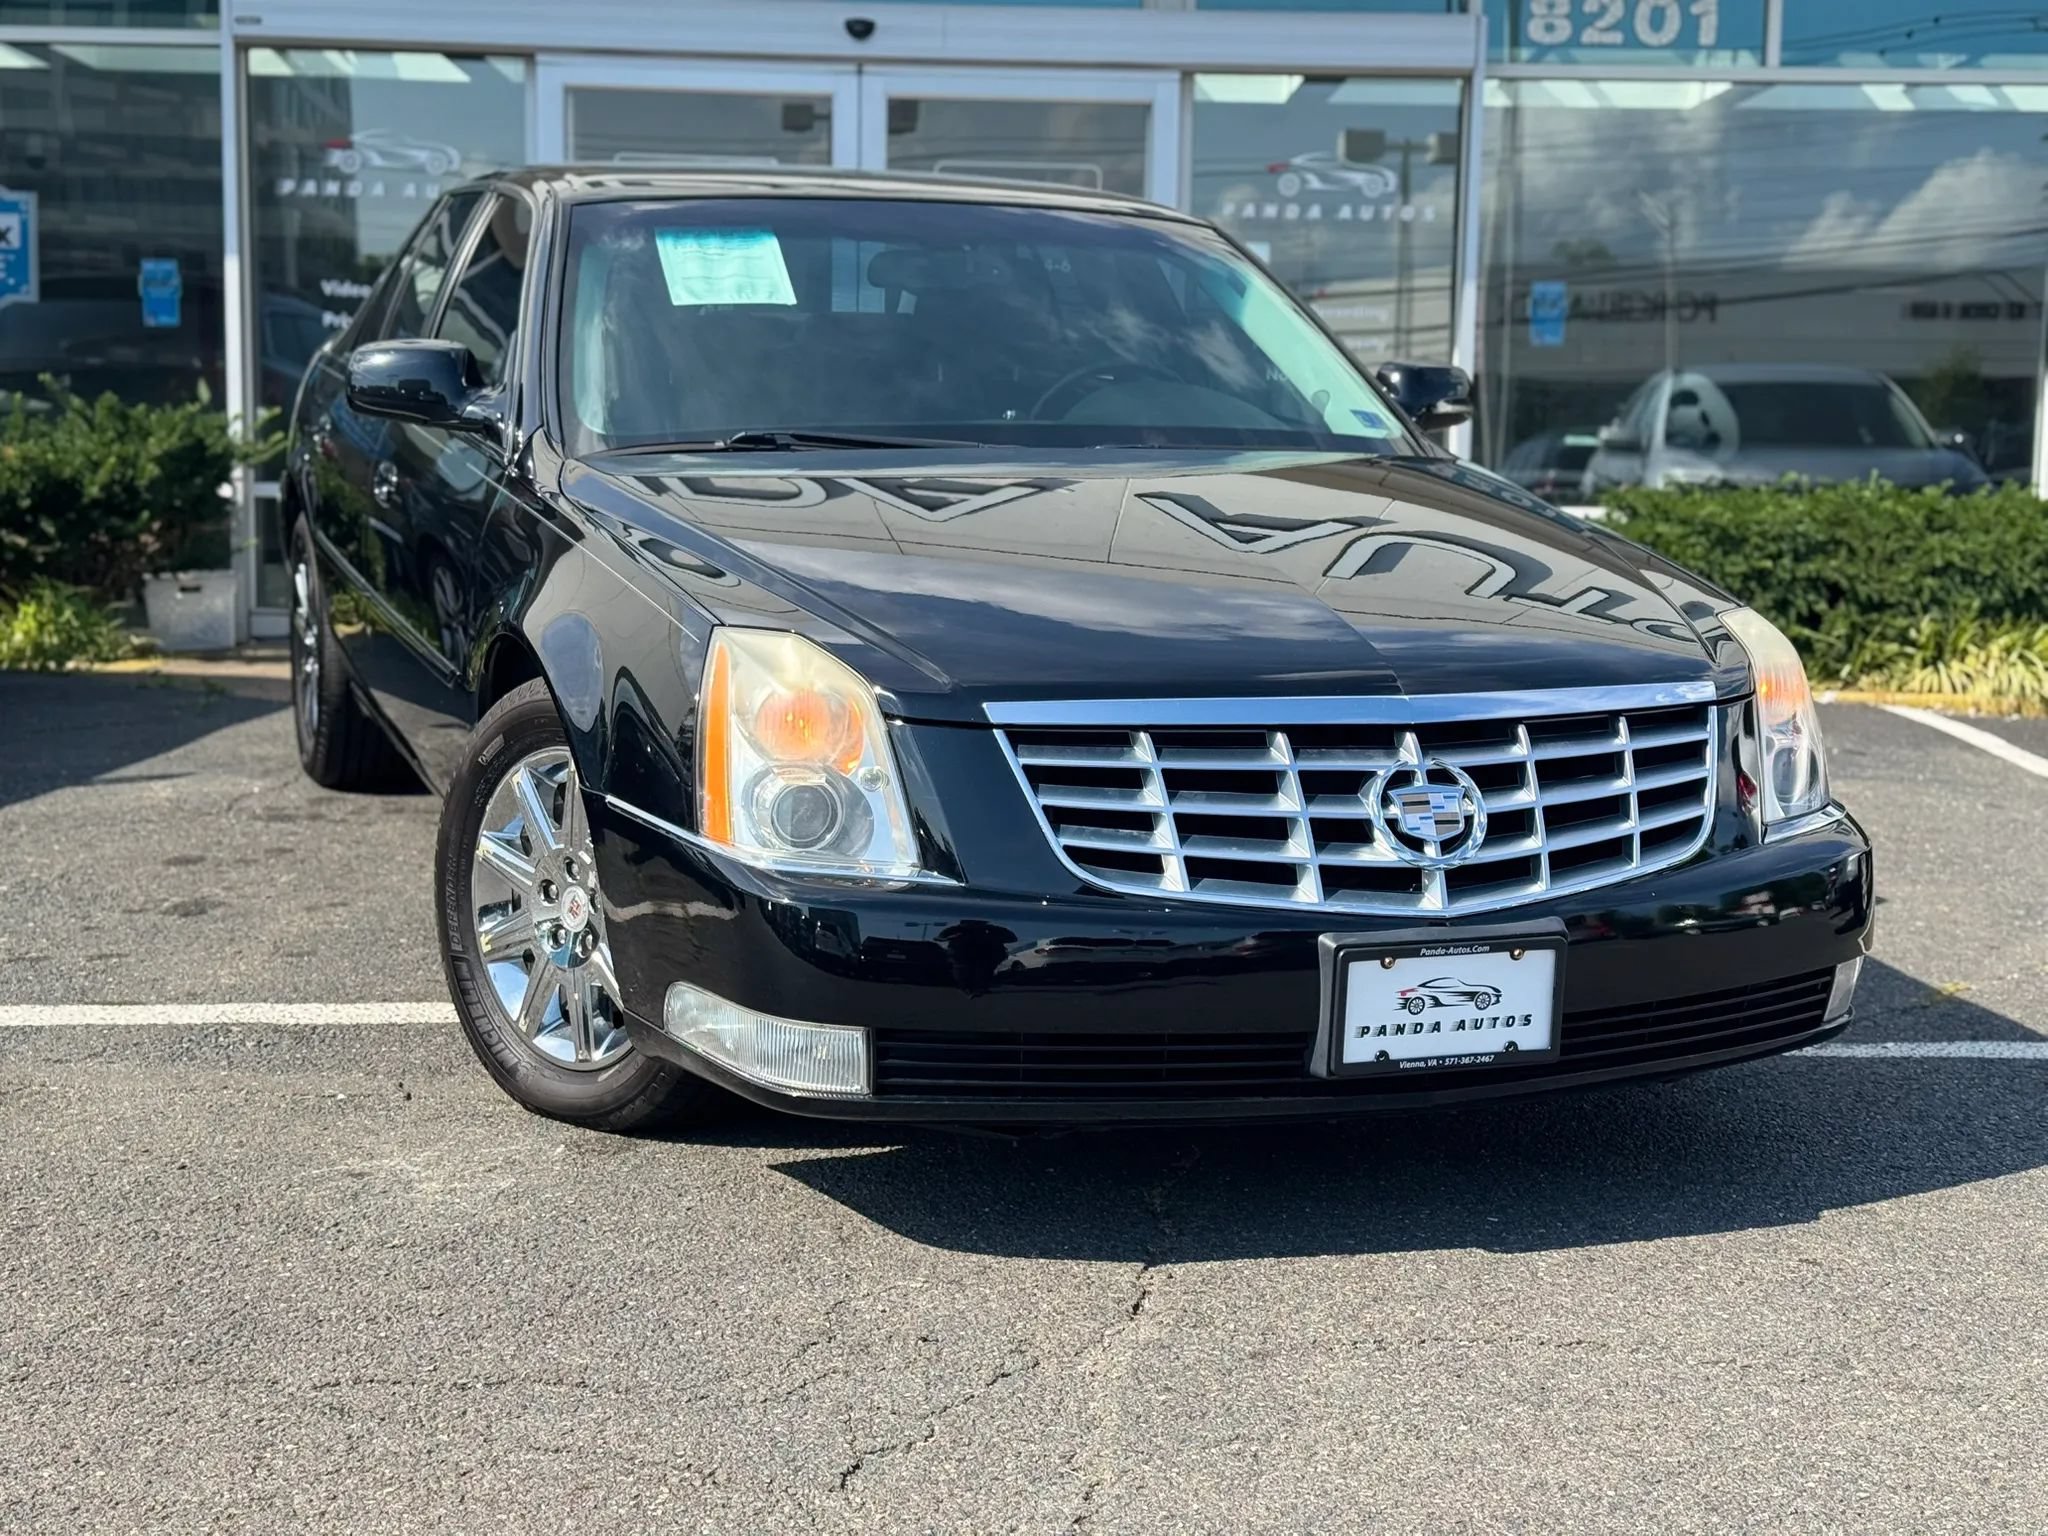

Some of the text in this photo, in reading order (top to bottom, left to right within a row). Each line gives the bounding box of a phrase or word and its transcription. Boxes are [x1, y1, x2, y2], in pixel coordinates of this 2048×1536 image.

[1526, 0, 1719, 47] 8201
[277, 177, 442, 199] PANDA AU
[1221, 202, 1437, 222] PANDA AUTOS
[1419, 945, 1490, 956] Panda-Autos.Com
[454, 960, 519, 1070] MICHELIN
[1355, 1014, 1533, 1038] PANDA AUTOS
[1399, 1055, 1495, 1070] Vienna, VA 571-367-2467
